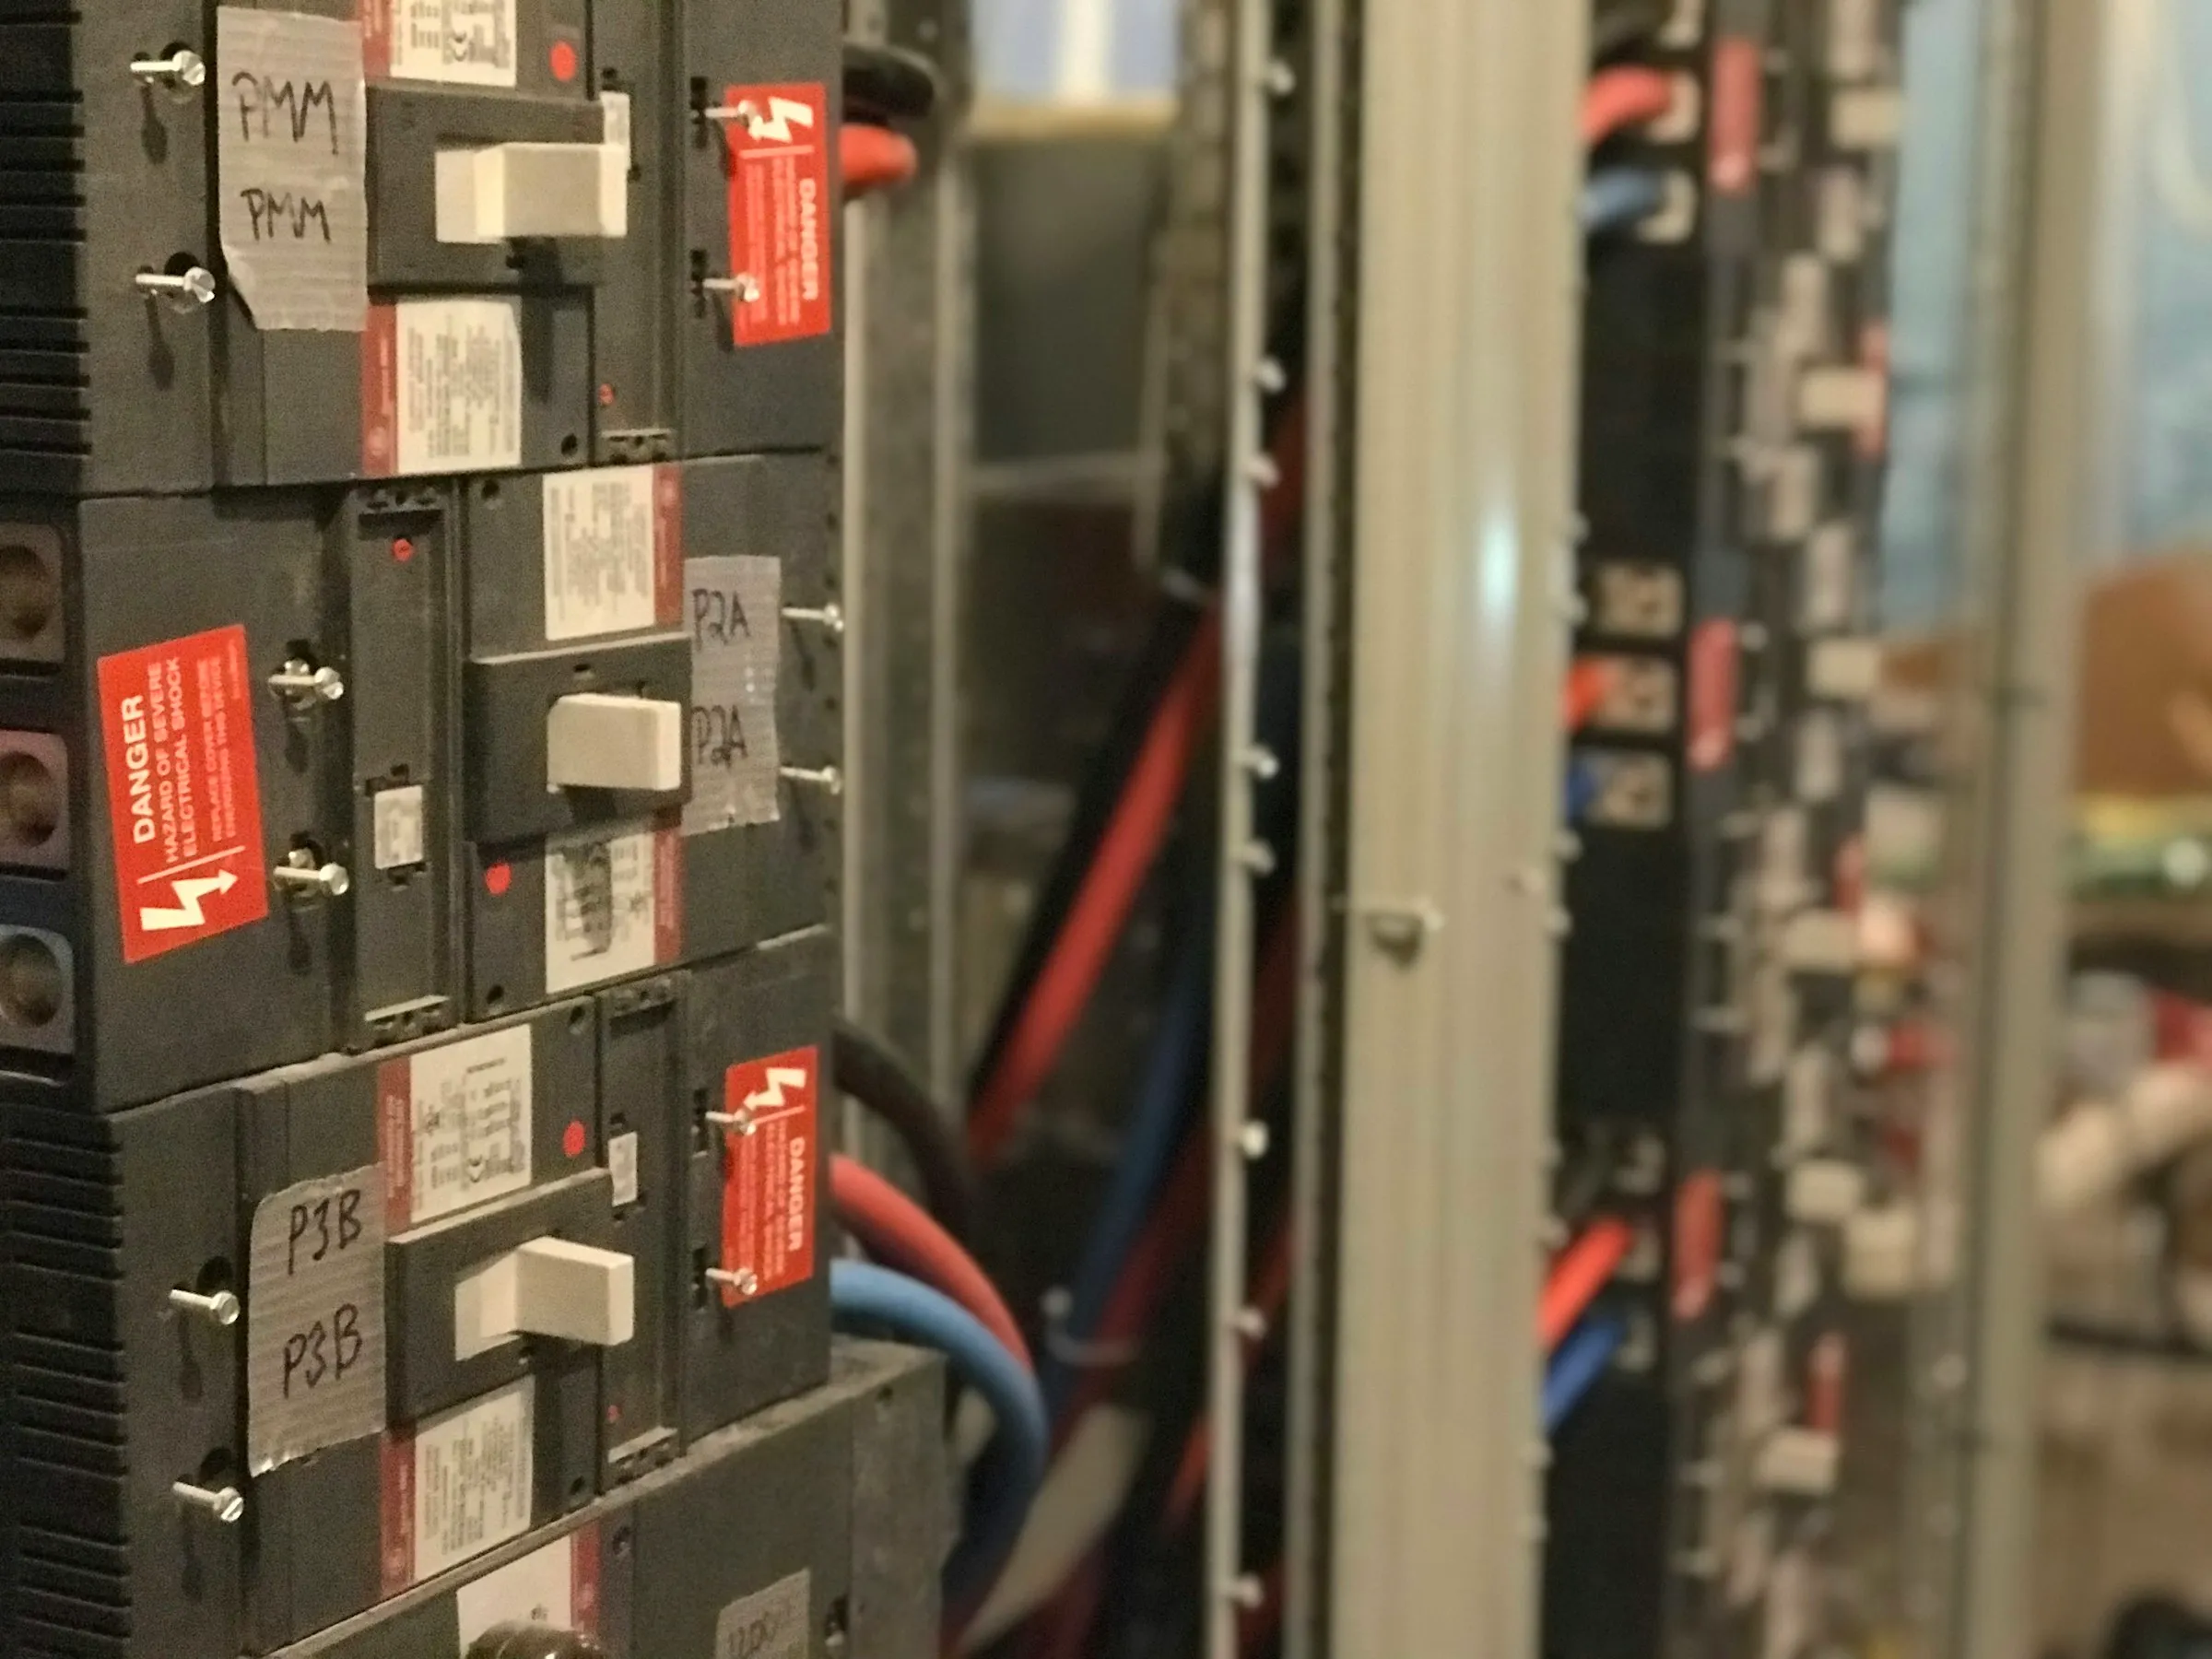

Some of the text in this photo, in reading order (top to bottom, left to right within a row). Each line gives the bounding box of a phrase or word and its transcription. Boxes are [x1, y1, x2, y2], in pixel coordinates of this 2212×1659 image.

[232, 71, 339, 156] PMM
[241, 187, 332, 245] PMM
[799, 177, 819, 301] DANGER
[692, 588, 752, 653] P2A
[121, 694, 156, 844] DANGER
[147, 661, 179, 864] HAZARD OF SEVERE
[166, 656, 198, 857] ELECTRICAL SHOCK
[691, 704, 749, 770] P2A
[288, 1188, 363, 1276] P3B
[787, 1135, 806, 1253] DANGER
[283, 1302, 363, 1400] P3B
